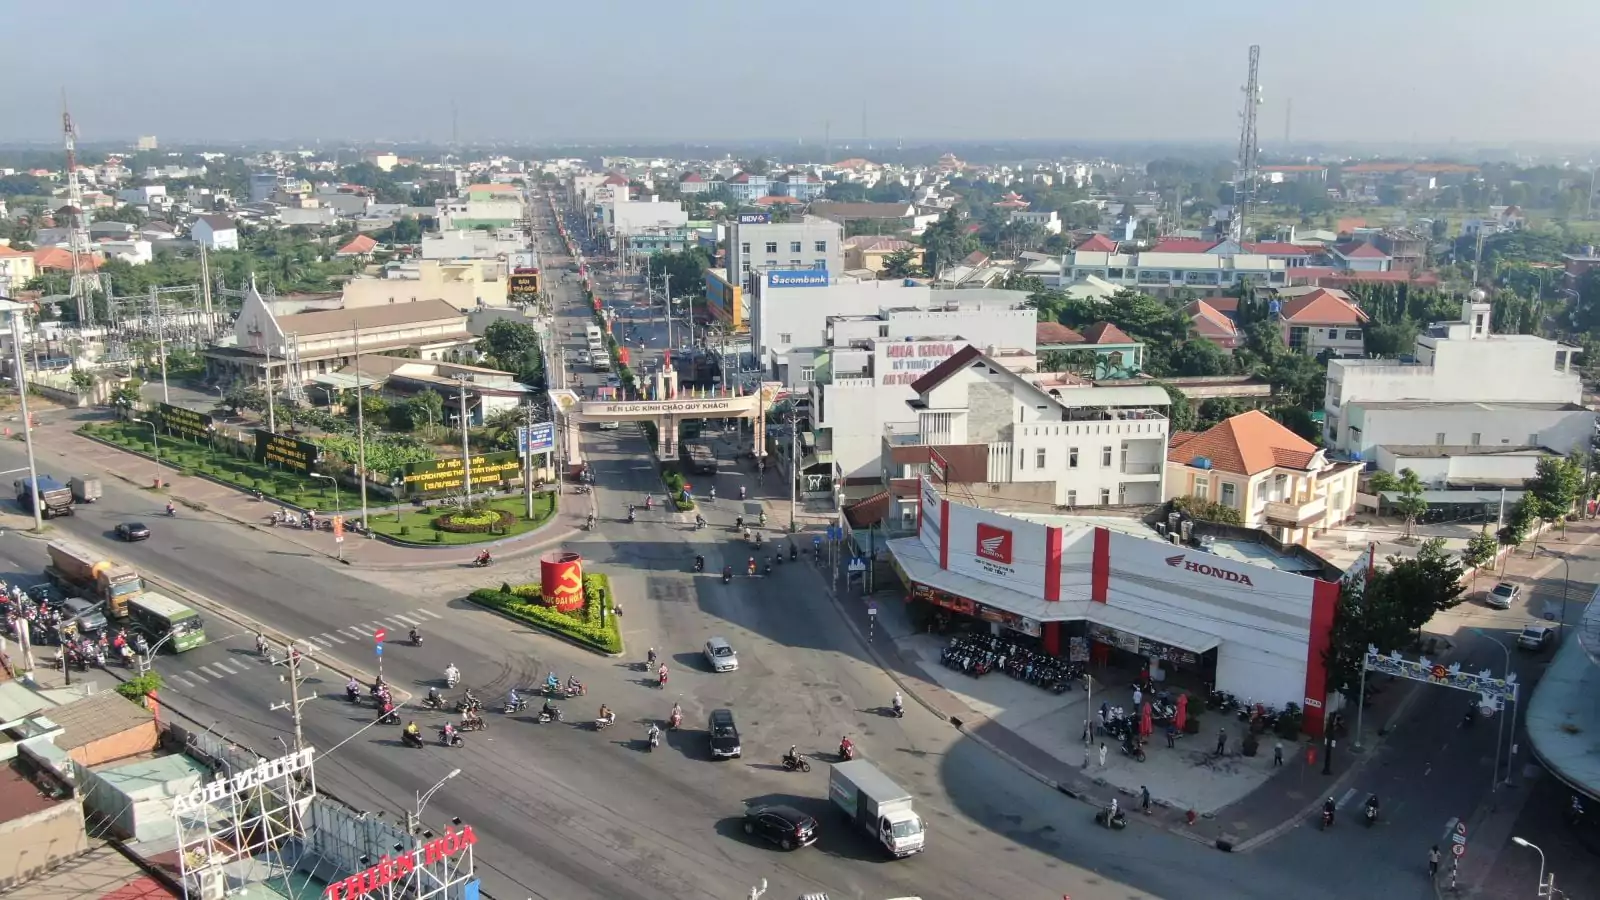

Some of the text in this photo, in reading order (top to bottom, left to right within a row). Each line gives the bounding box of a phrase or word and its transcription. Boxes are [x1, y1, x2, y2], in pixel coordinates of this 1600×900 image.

[771, 274, 826, 284] Sacombank
[887, 343, 955, 358] NHA KHOA
[906, 359, 932, 371] THUẬT
[607, 403, 623, 412] BẾN
[625, 404, 641, 412] LỨC
[642, 404, 660, 412] KÍNH
[662, 402, 684, 411] CHÀO
[702, 401, 729, 409] KHÁCH
[980, 548, 1004, 560] HONDA
[1184, 560, 1254, 587] HONDA
[325, 824, 478, 900] THIÊN HÒA
